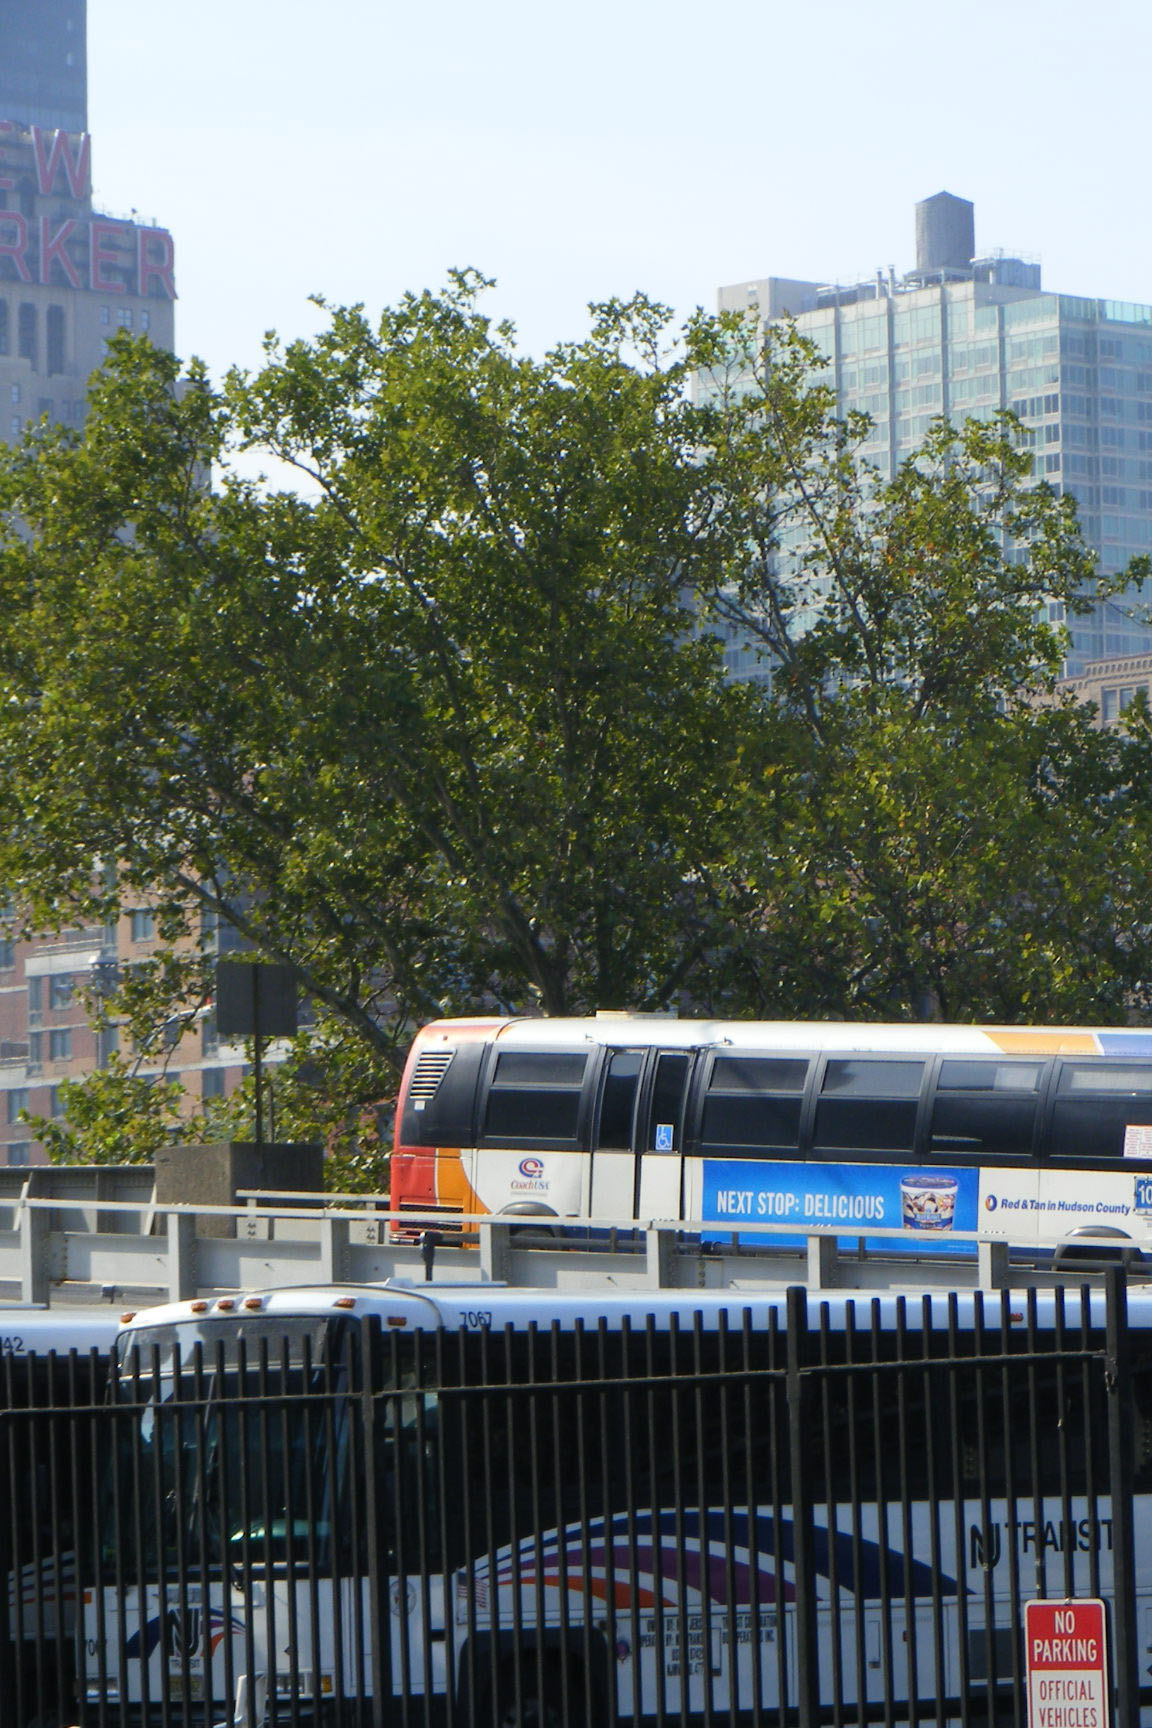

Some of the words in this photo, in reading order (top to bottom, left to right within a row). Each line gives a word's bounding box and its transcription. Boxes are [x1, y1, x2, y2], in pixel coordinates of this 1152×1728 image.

[717, 1191, 753, 1213] NEXT
[757, 1192, 800, 1215] STOP:
[804, 1194, 885, 1219] DELICIOUS
[1001, 1199, 1019, 1209] Red
[1021, 1200, 1028, 1209] &
[1029, 1200, 1045, 1211] Tan
[1047, 1200, 1056, 1211] in
[1058, 1202, 1094, 1213] Hudson
[1096, 1203, 1131, 1216] County
[460, 1311, 492, 1329] 7067
[0, 1336, 24, 1352] 42
[1005, 1518, 1115, 1553] TRANST
[1055, 1611, 1075, 1634] NO
[1034, 1639, 1097, 1662] PARKING
[1040, 1681, 1094, 1701] OFFICIAL
[1040, 1708, 1097, 1728] VEHICLES
